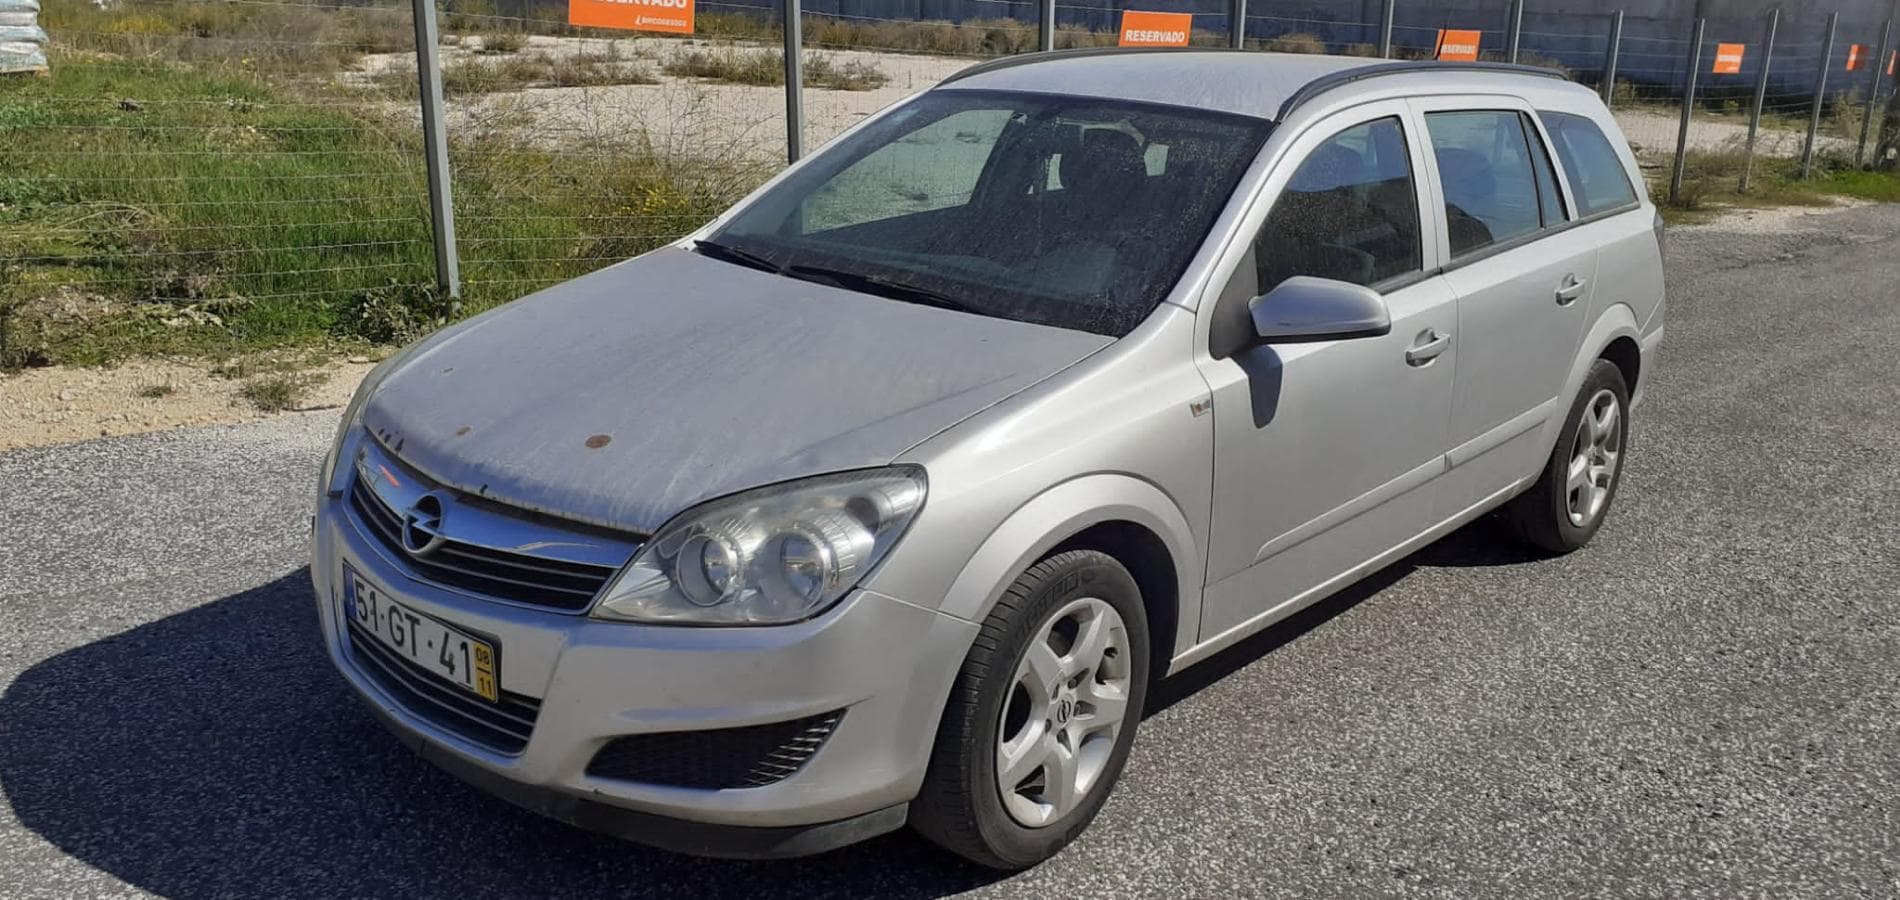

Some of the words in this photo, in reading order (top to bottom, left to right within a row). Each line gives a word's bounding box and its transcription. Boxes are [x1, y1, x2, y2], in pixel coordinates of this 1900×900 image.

[1125, 30, 1185, 42] RESERVADO
[476, 647, 490, 665] 08
[480, 677, 492, 695] 11
